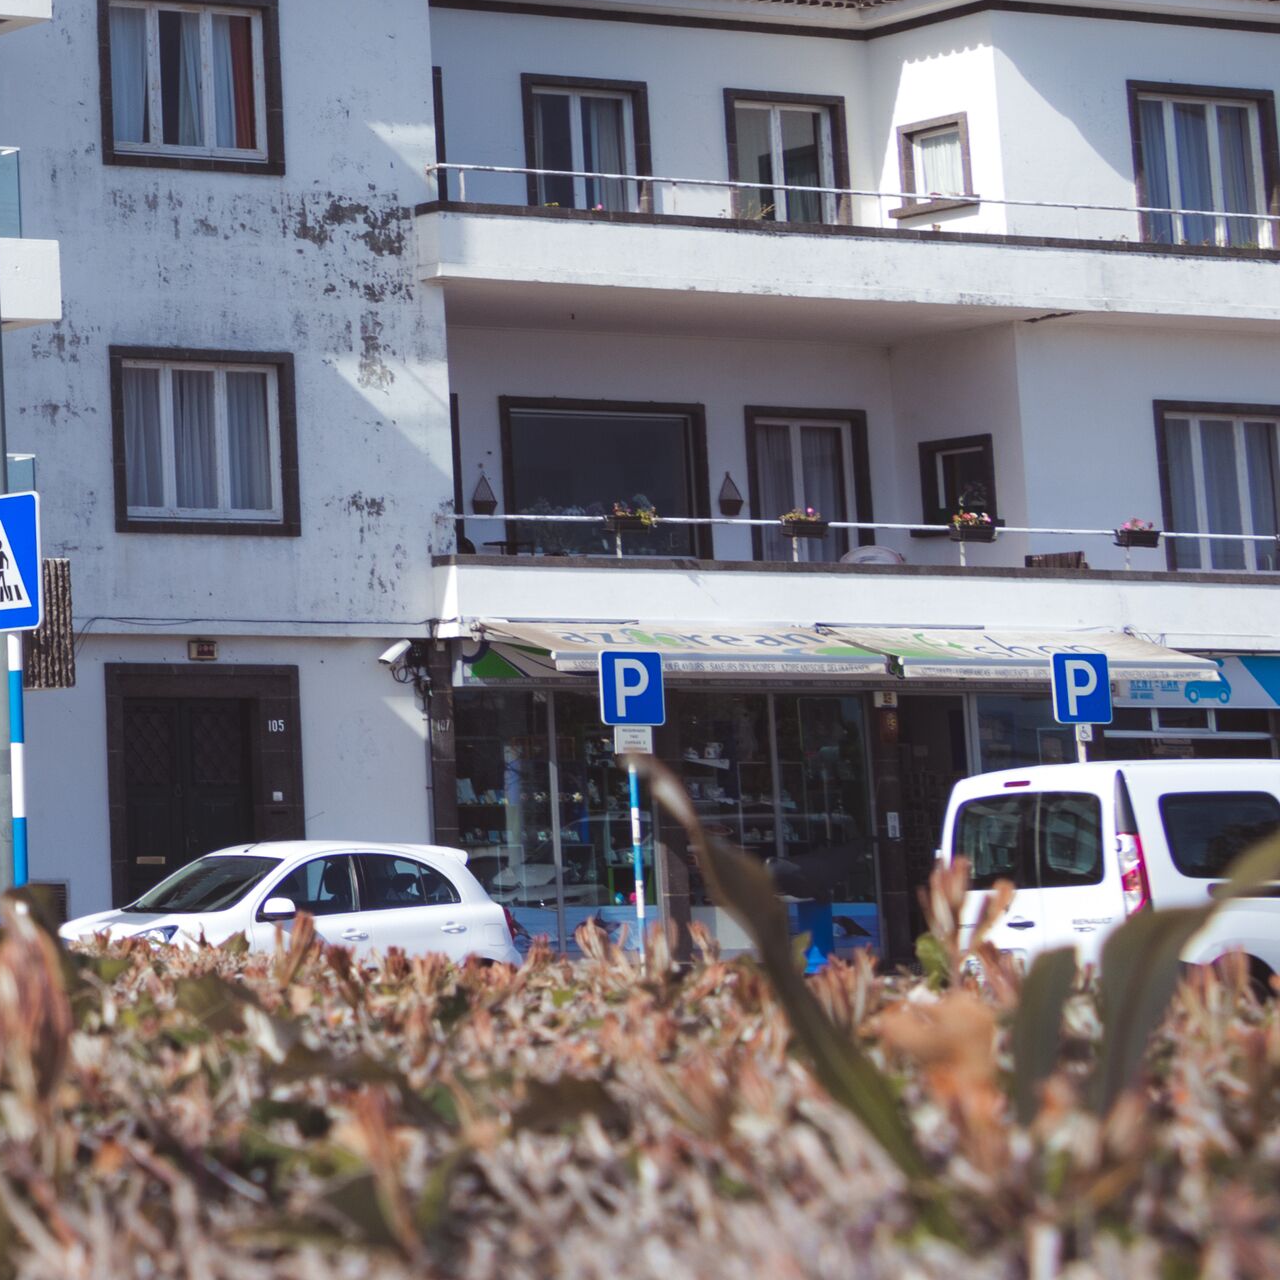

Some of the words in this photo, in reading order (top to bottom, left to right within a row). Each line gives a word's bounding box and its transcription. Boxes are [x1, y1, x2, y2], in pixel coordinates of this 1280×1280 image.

[614, 658, 650, 718] P
[1064, 659, 1098, 717] P
[268, 719, 285, 732] 105
